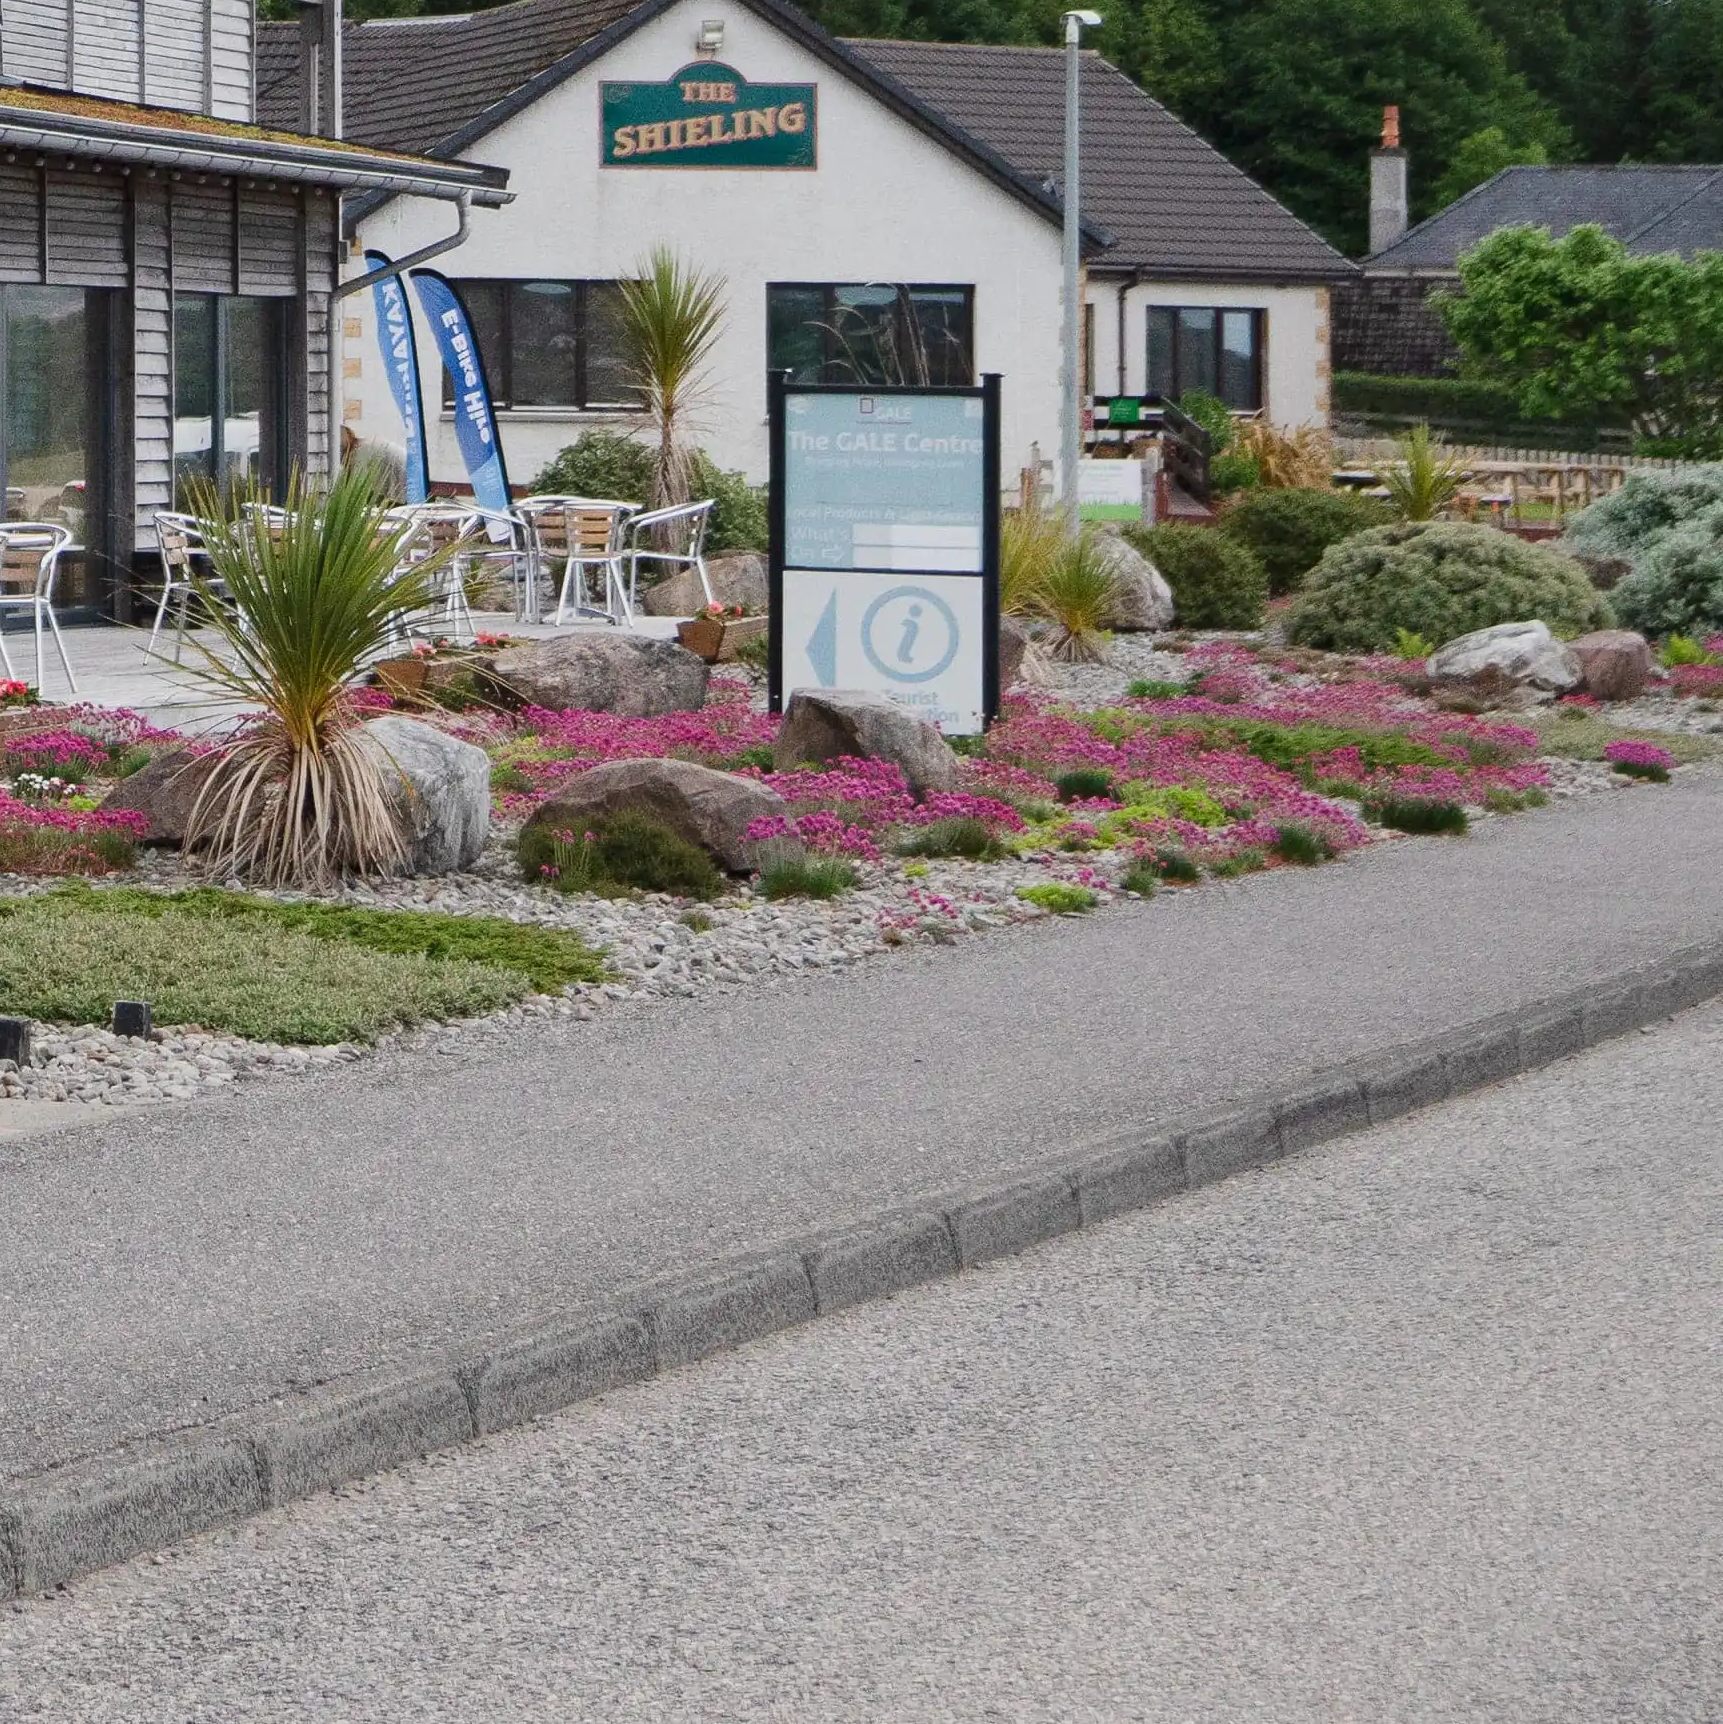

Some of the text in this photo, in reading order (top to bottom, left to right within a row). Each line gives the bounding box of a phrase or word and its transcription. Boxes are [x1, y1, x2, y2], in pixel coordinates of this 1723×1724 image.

[679, 82, 737, 104] THE
[612, 102, 806, 158] SHIELING
[441, 308, 478, 389] E-Bike
[874, 406, 913, 420] GALE
[788, 431, 983, 455] The GALE Centre
